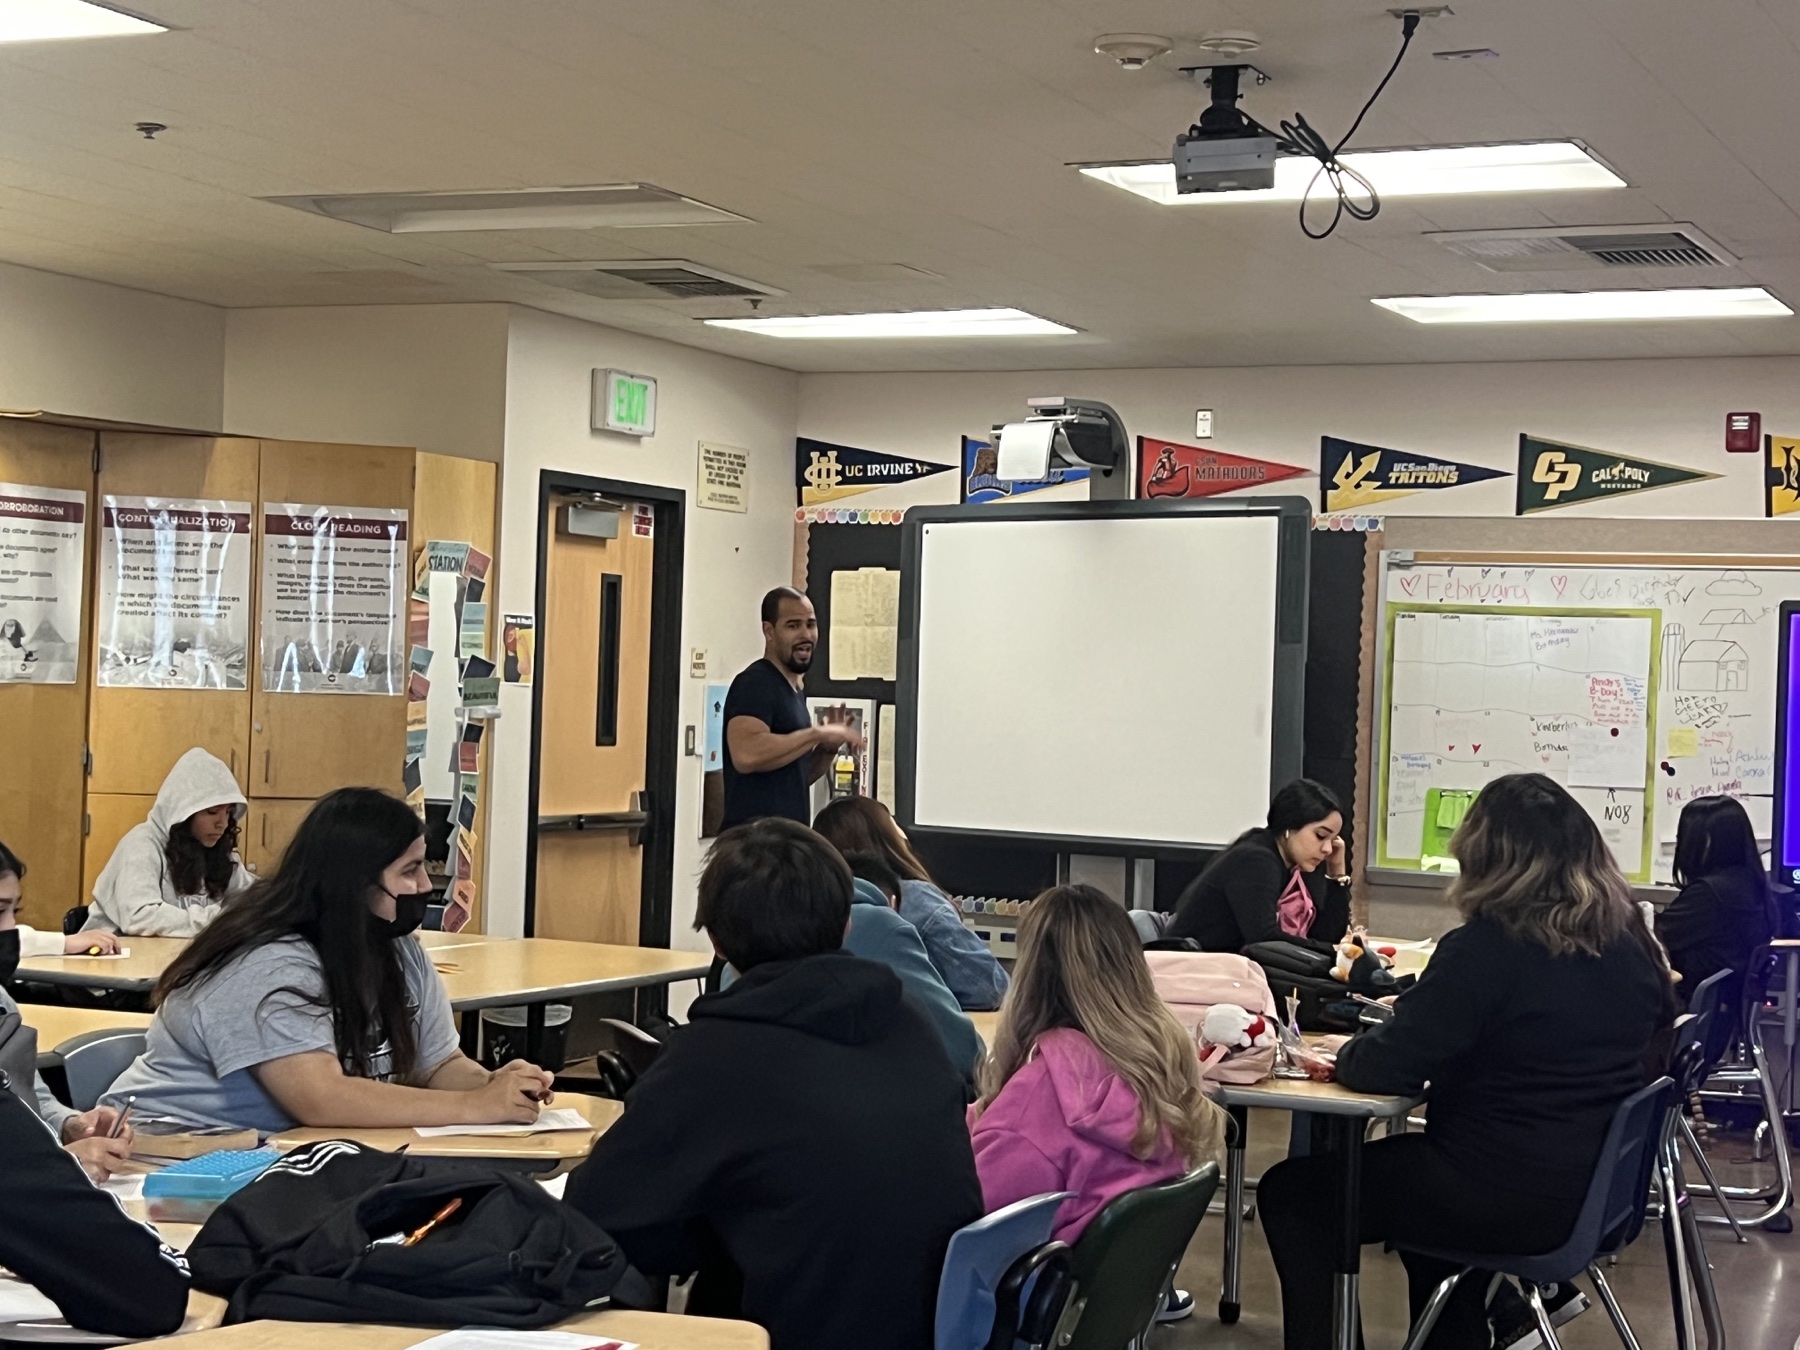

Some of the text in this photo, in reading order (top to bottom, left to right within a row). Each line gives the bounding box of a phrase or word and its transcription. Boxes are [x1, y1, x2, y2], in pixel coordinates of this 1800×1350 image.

[615, 379, 647, 426] EXIT
[845, 463, 913, 476] UC IRVINE
[1195, 466, 1265, 480] MATADORS
[1388, 472, 1459, 484] TRITONS
[1532, 451, 1582, 500] CP
[1592, 466, 1650, 483] CAL POLY
[428, 554, 464, 573] STATION
[1426, 573, 1531, 604] February
